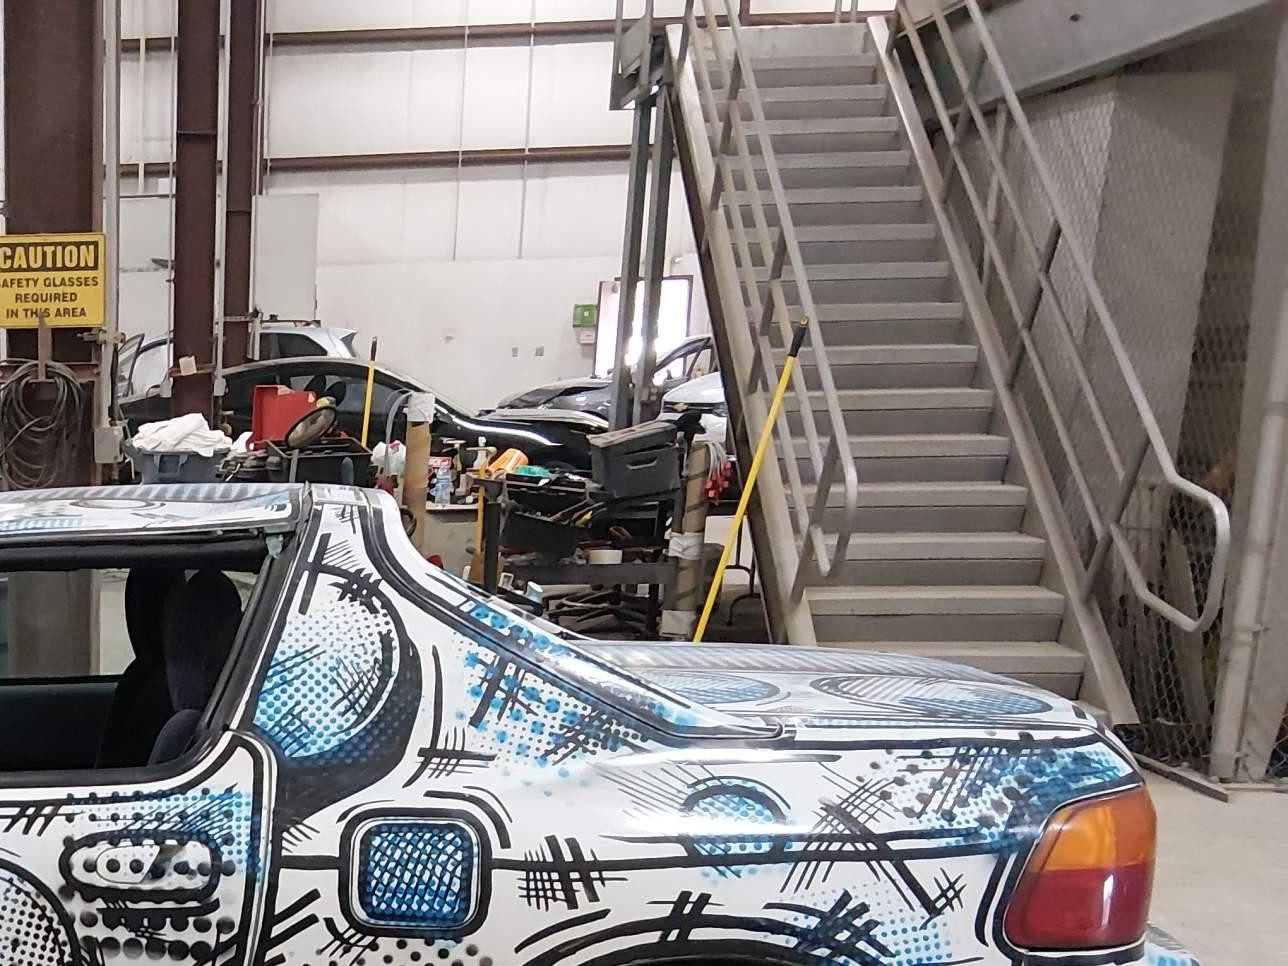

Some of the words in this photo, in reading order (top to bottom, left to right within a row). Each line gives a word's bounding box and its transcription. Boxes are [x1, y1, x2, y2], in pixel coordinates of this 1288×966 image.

[43, 276, 99, 287] GLASSES
[15, 292, 78, 303] REQUIRED
[6, 309, 19, 319] IN
[54, 307, 87, 318] AREA
